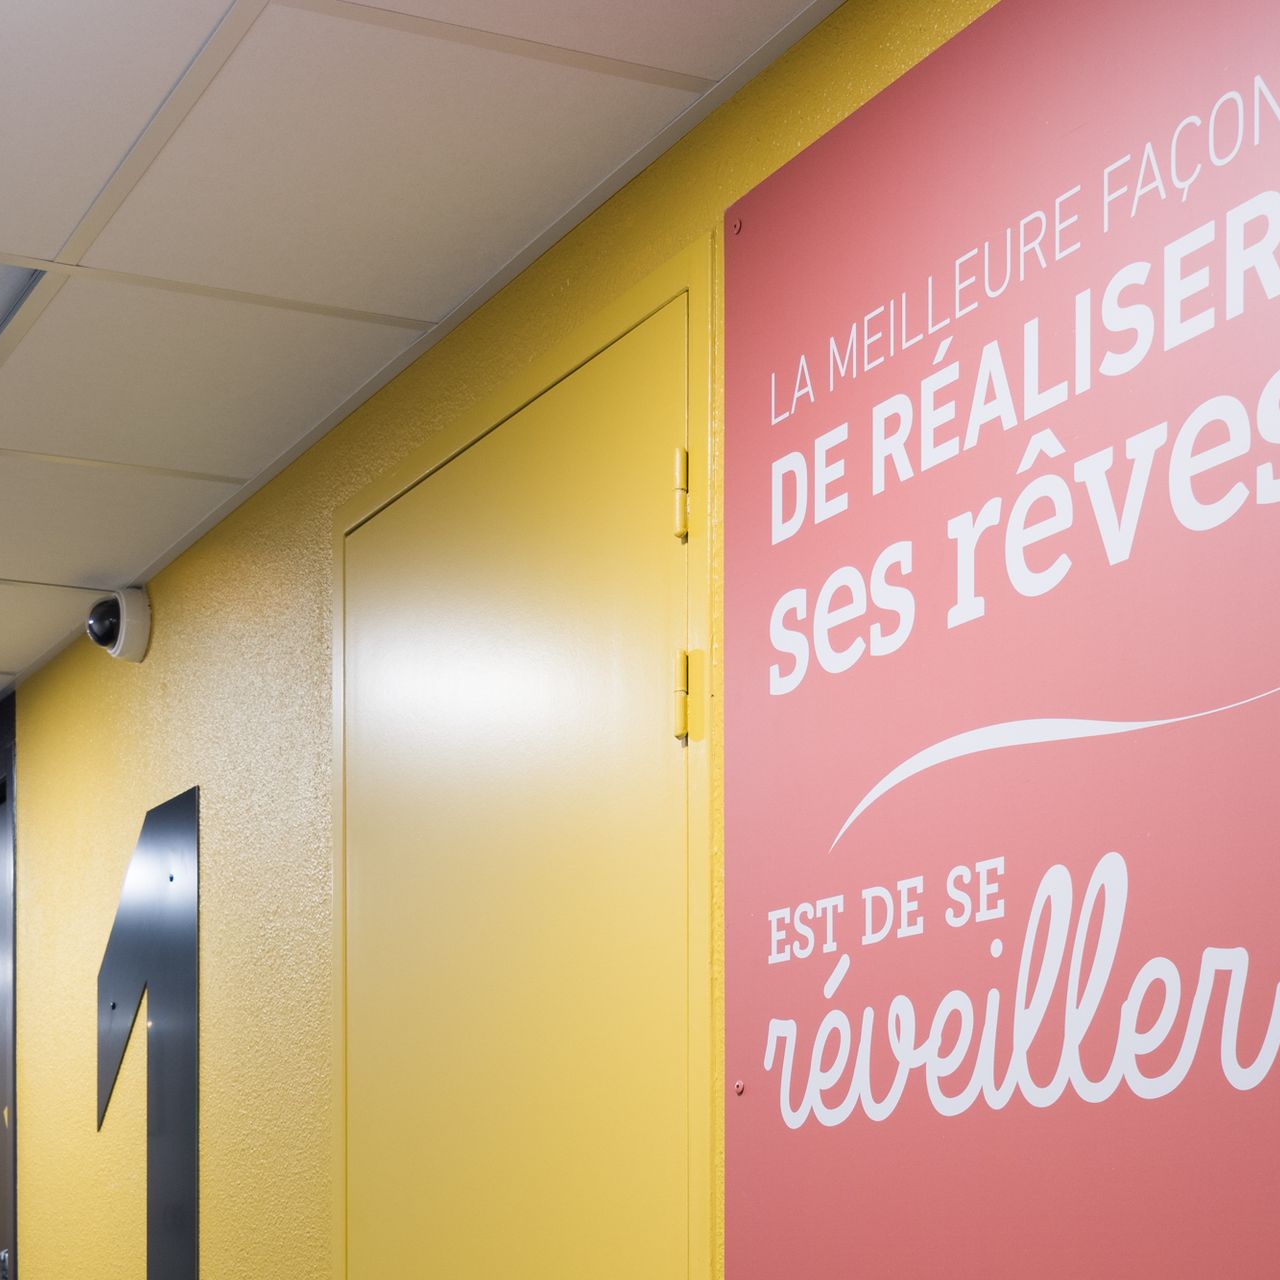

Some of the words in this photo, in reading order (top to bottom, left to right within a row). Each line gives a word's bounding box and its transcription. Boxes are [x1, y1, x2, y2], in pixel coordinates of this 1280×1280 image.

[770, 354, 815, 426] LA
[829, 184, 1081, 393] MEILLEURE
[771, 422, 849, 546] DE
[769, 539, 916, 696] ses
[767, 894, 845, 965] EST
[861, 875, 925, 946] DE
[944, 855, 1006, 928] SE
